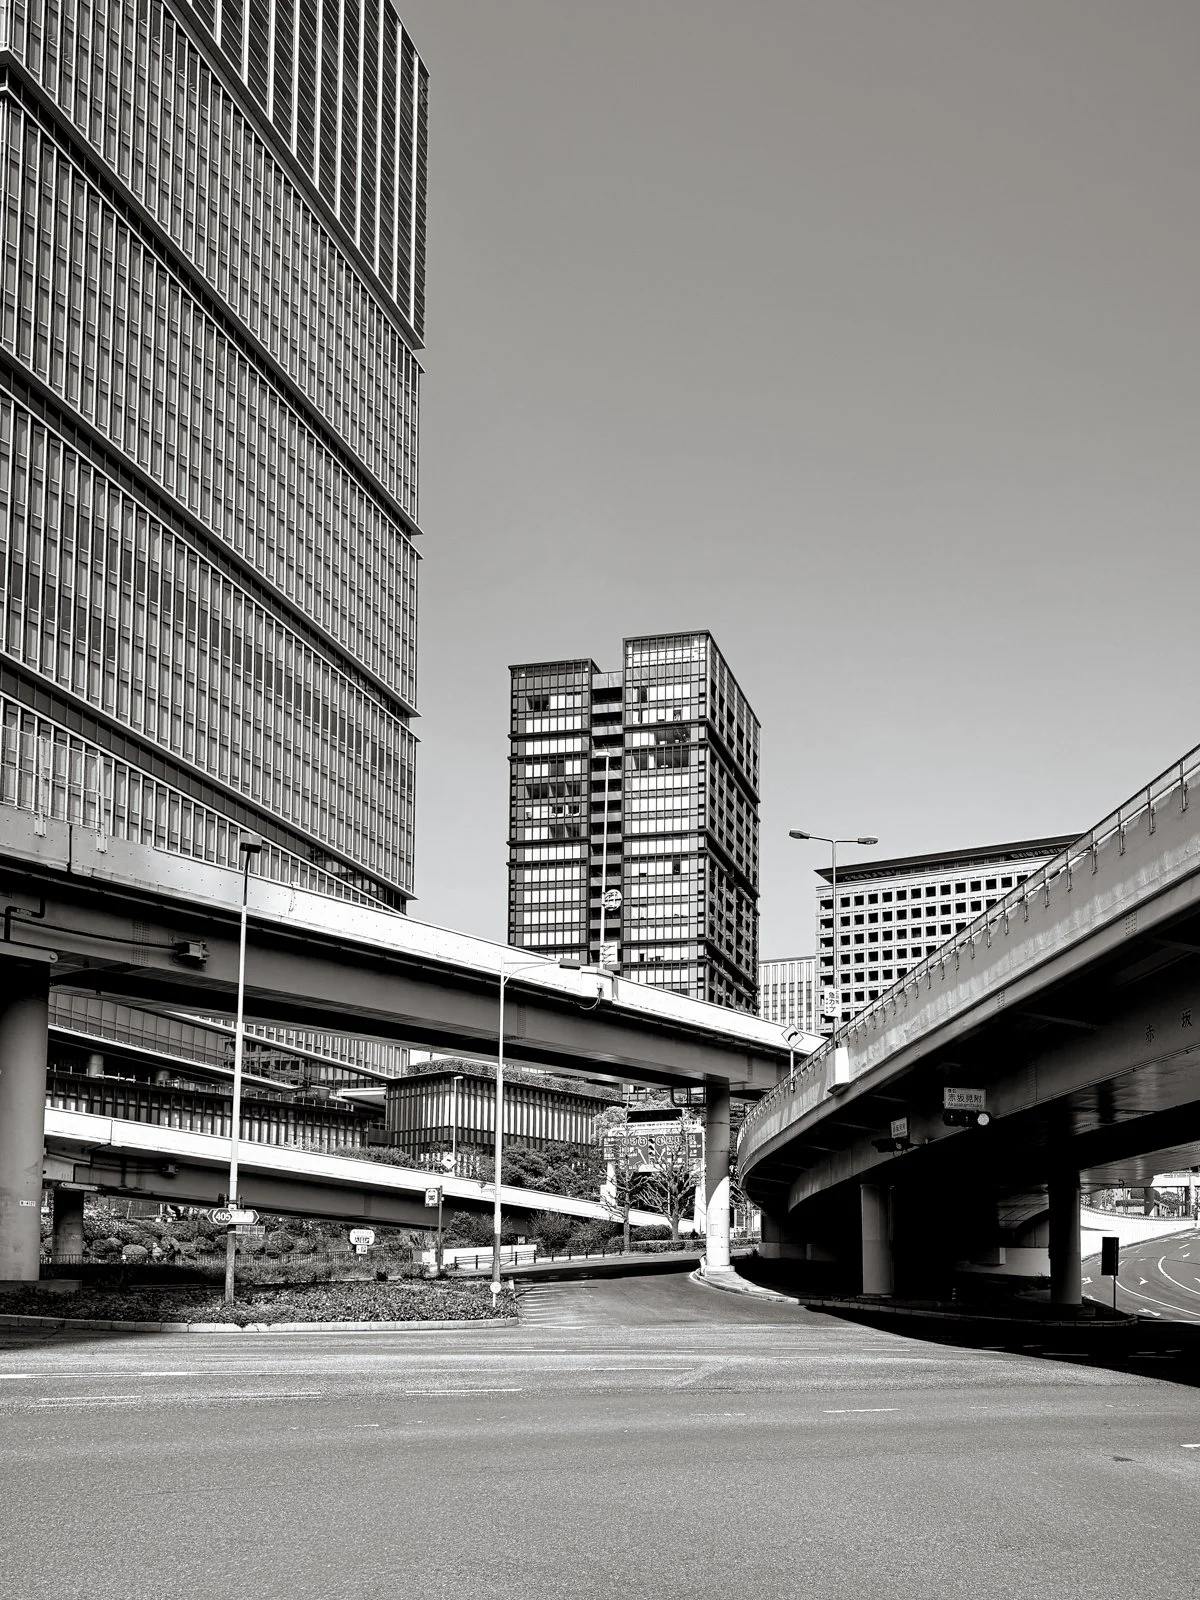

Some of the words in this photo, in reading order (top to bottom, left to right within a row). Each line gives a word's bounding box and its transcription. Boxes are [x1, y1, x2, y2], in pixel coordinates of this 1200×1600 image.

[947, 1093, 983, 1104] 赤坂見附
[215, 1212, 232, 1221] 405
